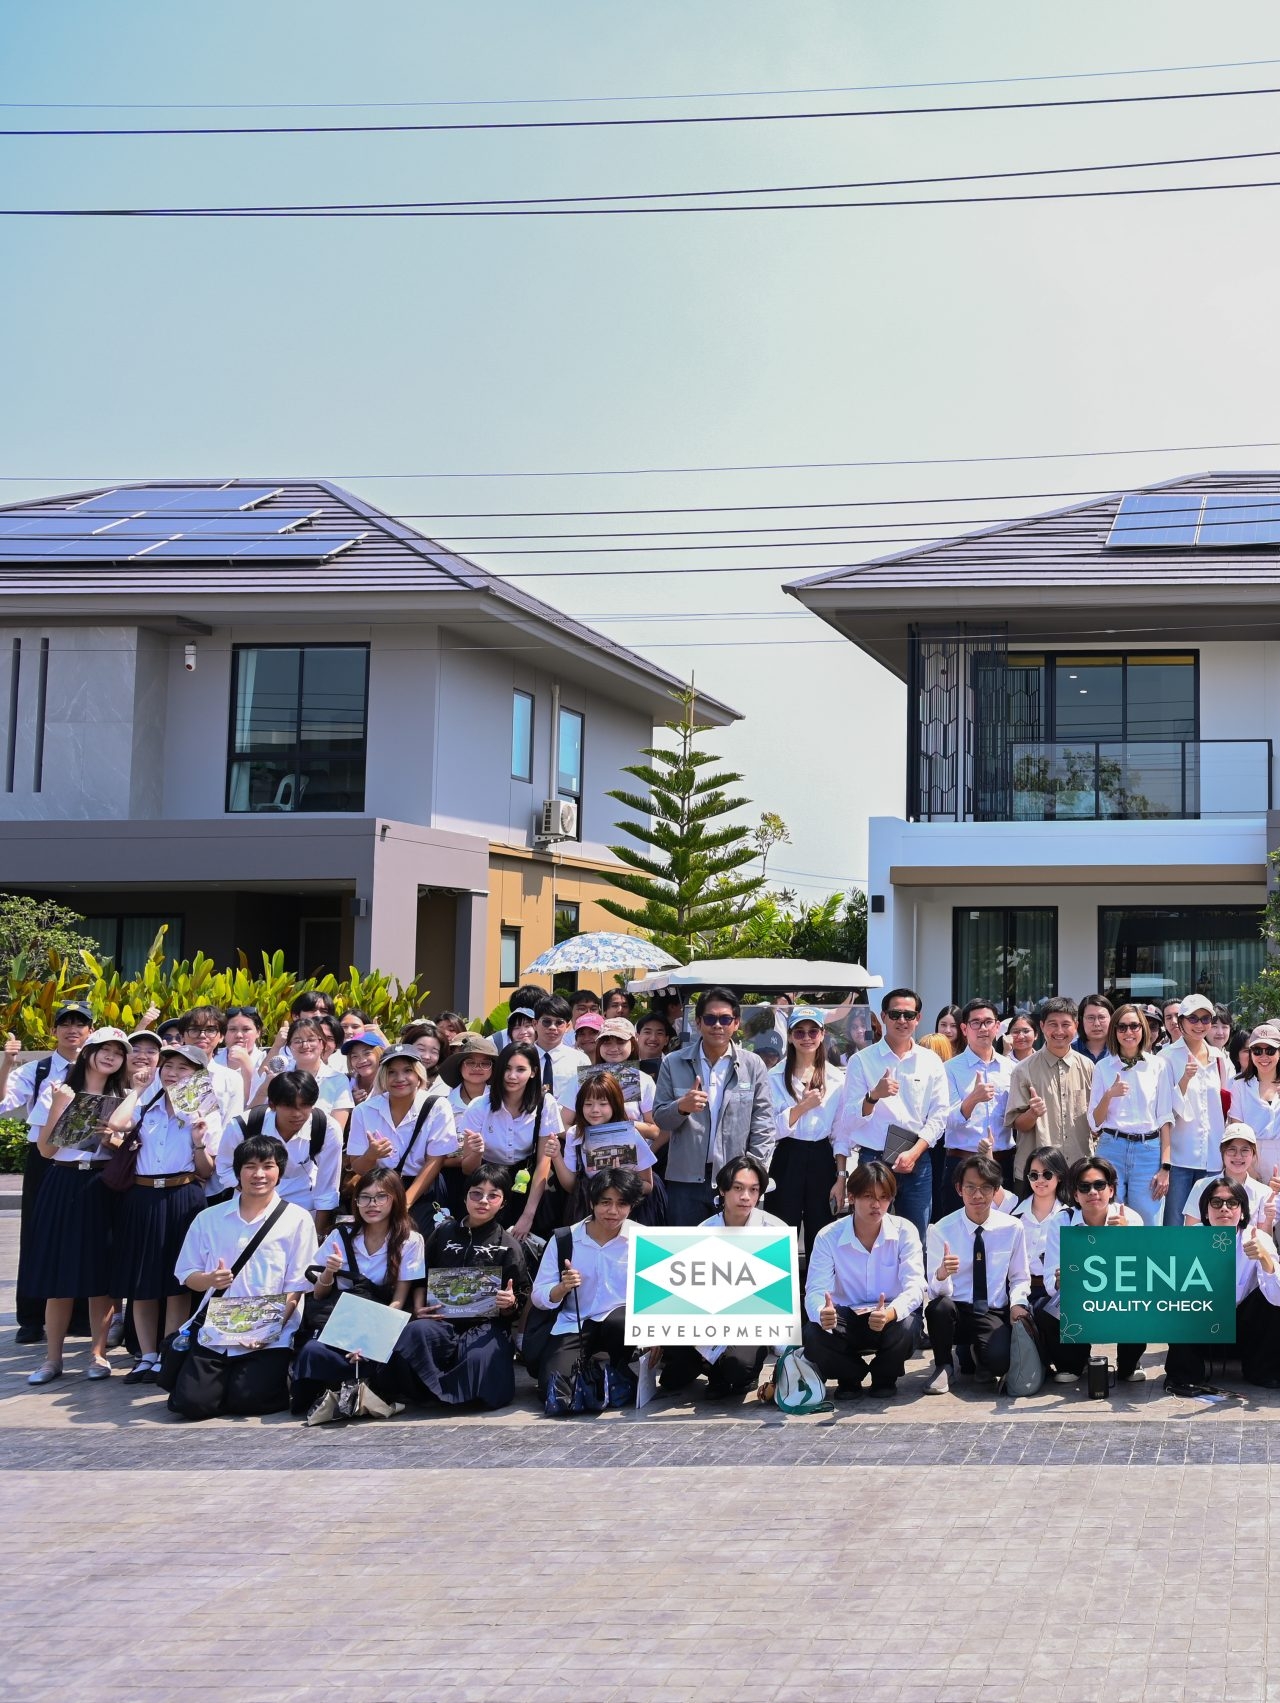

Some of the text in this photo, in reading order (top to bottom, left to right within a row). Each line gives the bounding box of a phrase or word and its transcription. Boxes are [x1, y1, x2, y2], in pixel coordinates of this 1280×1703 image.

[770, 1036, 778, 1045] NY
[669, 1261, 757, 1286] SENA
[1082, 1255, 1214, 1293] SENA
[1082, 1300, 1213, 1312] QUALITY CHECK
[632, 1326, 794, 1338] DEVELOPMENT
